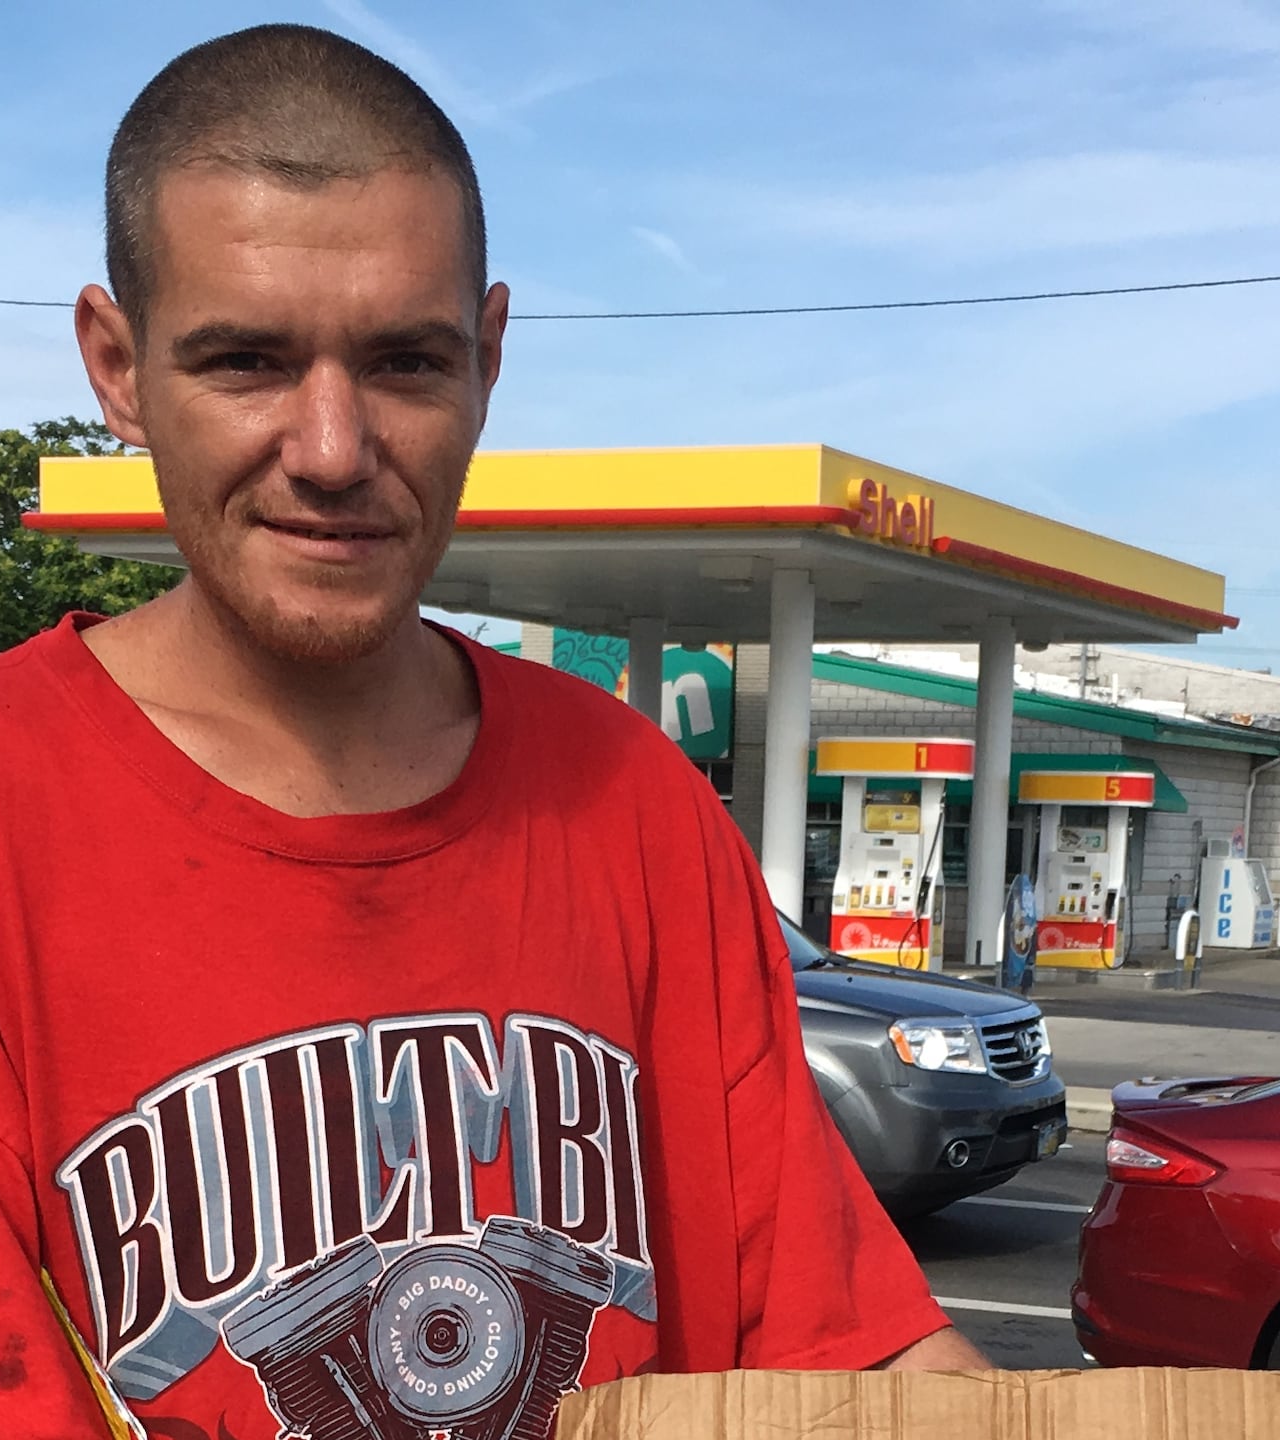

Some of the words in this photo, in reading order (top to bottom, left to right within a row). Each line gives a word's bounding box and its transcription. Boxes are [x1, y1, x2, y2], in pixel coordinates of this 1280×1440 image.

[860, 479, 934, 546] Shell
[918, 747, 928, 768] 1
[1106, 780, 1121, 798] 5
[58, 1016, 500, 1370] BUILT
[510, 1016, 652, 1272] BI
[398, 1282, 425, 1311] BIG
[429, 1275, 490, 1305] DADDY
[389, 1326, 438, 1397] COMPANY
[443, 1321, 501, 1396] CLOTHING
